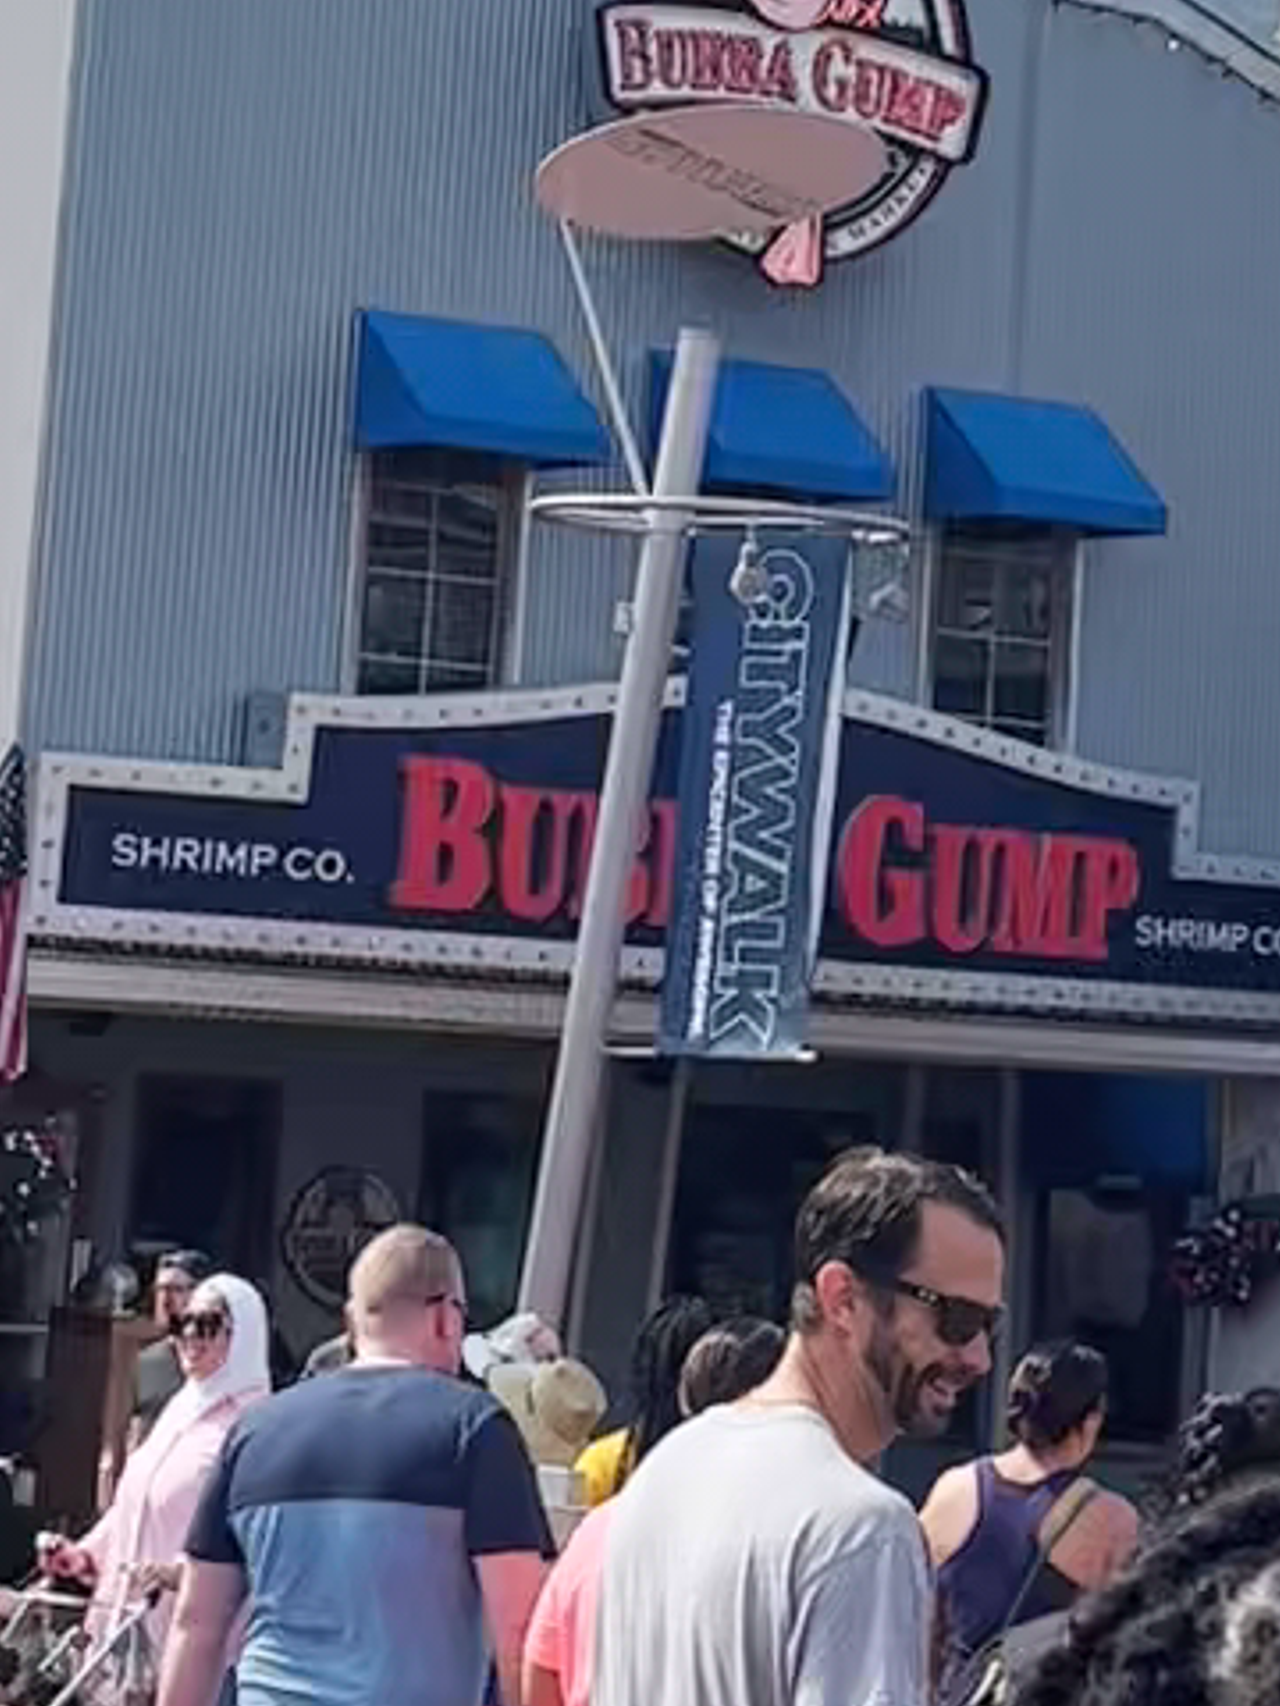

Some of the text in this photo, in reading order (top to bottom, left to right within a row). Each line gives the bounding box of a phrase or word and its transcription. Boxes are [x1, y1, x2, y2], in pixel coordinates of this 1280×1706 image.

[616, 20, 966, 142] BUBBA GUMP
[714, 699, 733, 743] THE
[709, 548, 813, 1050] CITYWALK
[111, 833, 354, 884] SHRIMP CO.
[838, 793, 1141, 960] GUMP
[1134, 913, 1250, 953] SHRIMP
